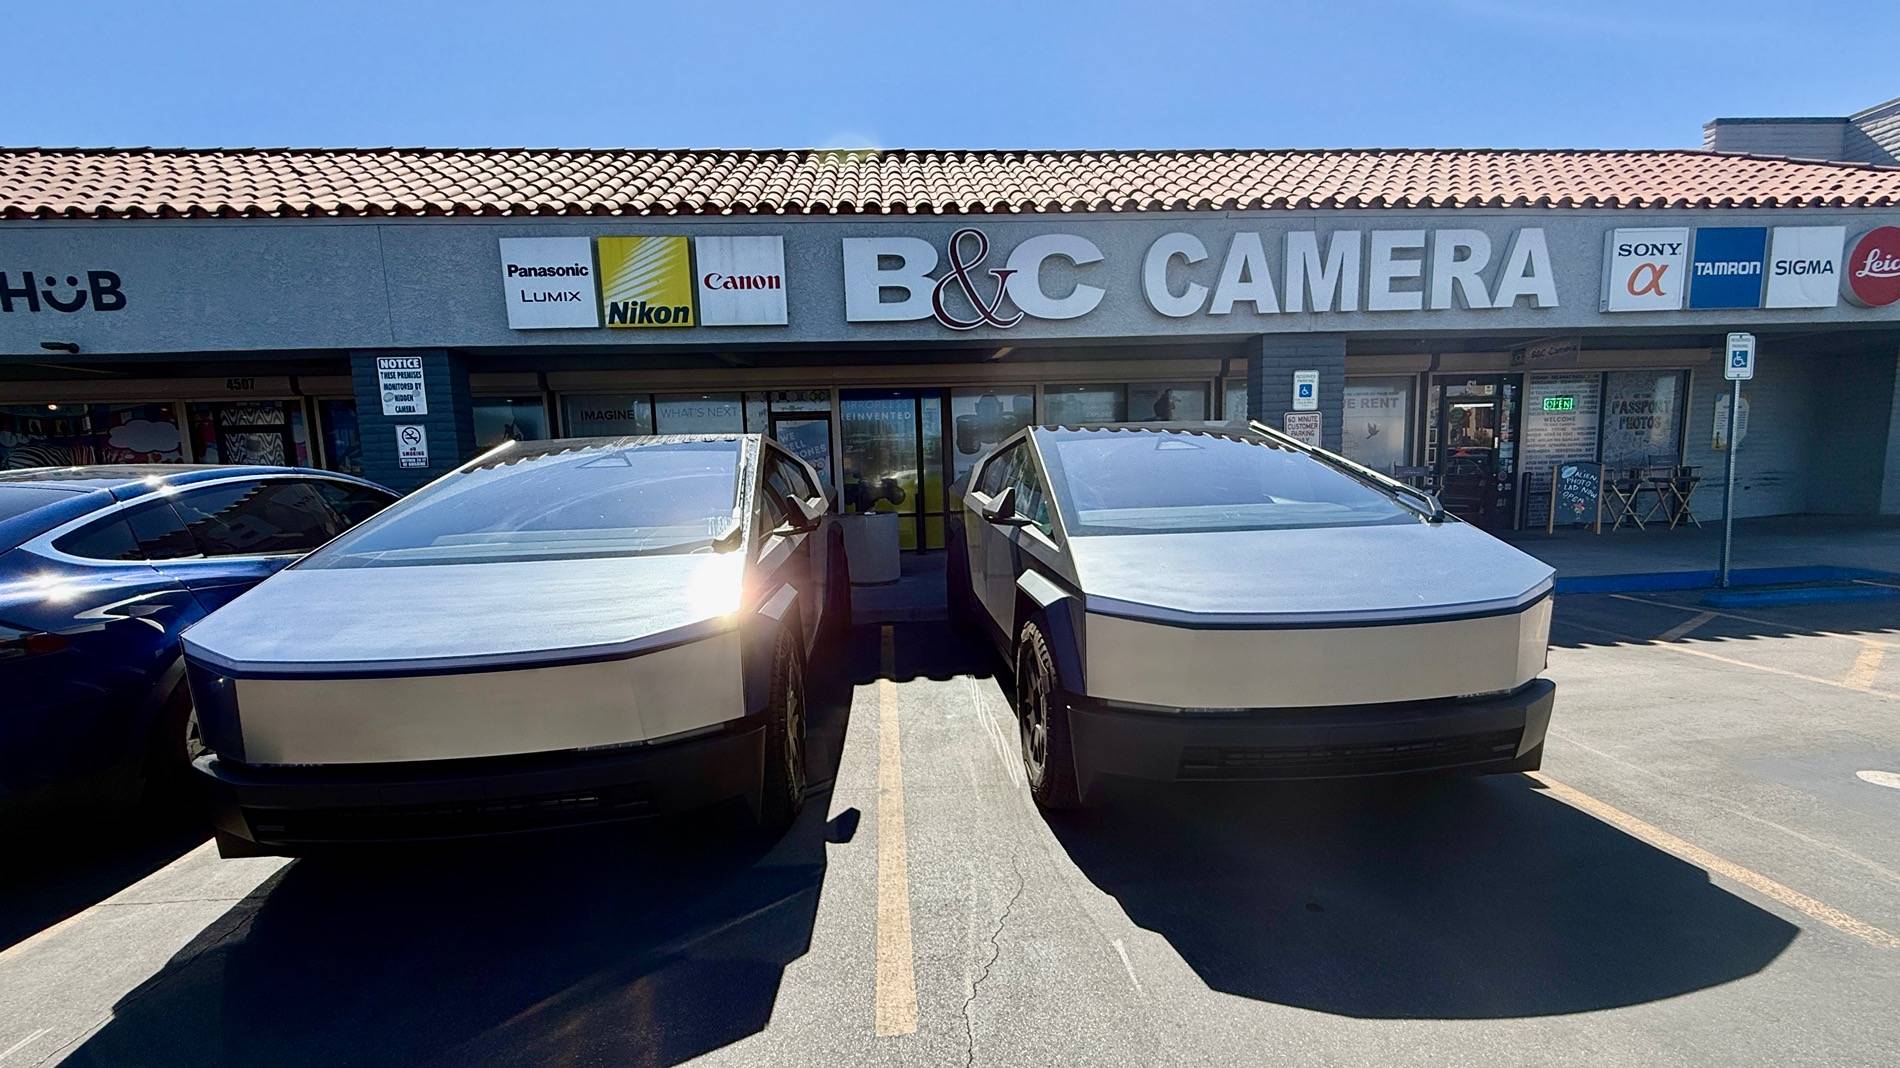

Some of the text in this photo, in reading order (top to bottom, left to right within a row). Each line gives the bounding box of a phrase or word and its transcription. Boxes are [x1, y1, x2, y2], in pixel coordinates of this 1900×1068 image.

[1618, 242, 1683, 257] SONY
[506, 262, 589, 278] Panasonic
[1694, 260, 1761, 277] TAMRON
[1775, 259, 1834, 276] SIGMA
[703, 272, 781, 291] Canon
[842, 227, 1560, 330] B&C CAMERA
[607, 301, 691, 325] Nikon
[380, 358, 420, 369] NOTICE
[380, 371, 422, 380] THESE PREMISES
[383, 382, 422, 391] MONITORED BY
[394, 394, 414, 402] HIDDEN
[1343, 397, 1400, 409] E RENT
[395, 405, 416, 414] CAMERA
[1545, 399, 1571, 410] OPEN
[1611, 399, 1671, 415] PASSPORT
[580, 409, 635, 421] IMAGINE
[661, 406, 738, 419] WHAT'S NEXT
[1297, 415, 1319, 423] MINUTE
[1618, 415, 1662, 430] PHOTOS
[1574, 471, 1597, 481] ALIEN
[1566, 477, 1592, 488] PHOTO
[1562, 490, 1585, 503] OPEN
